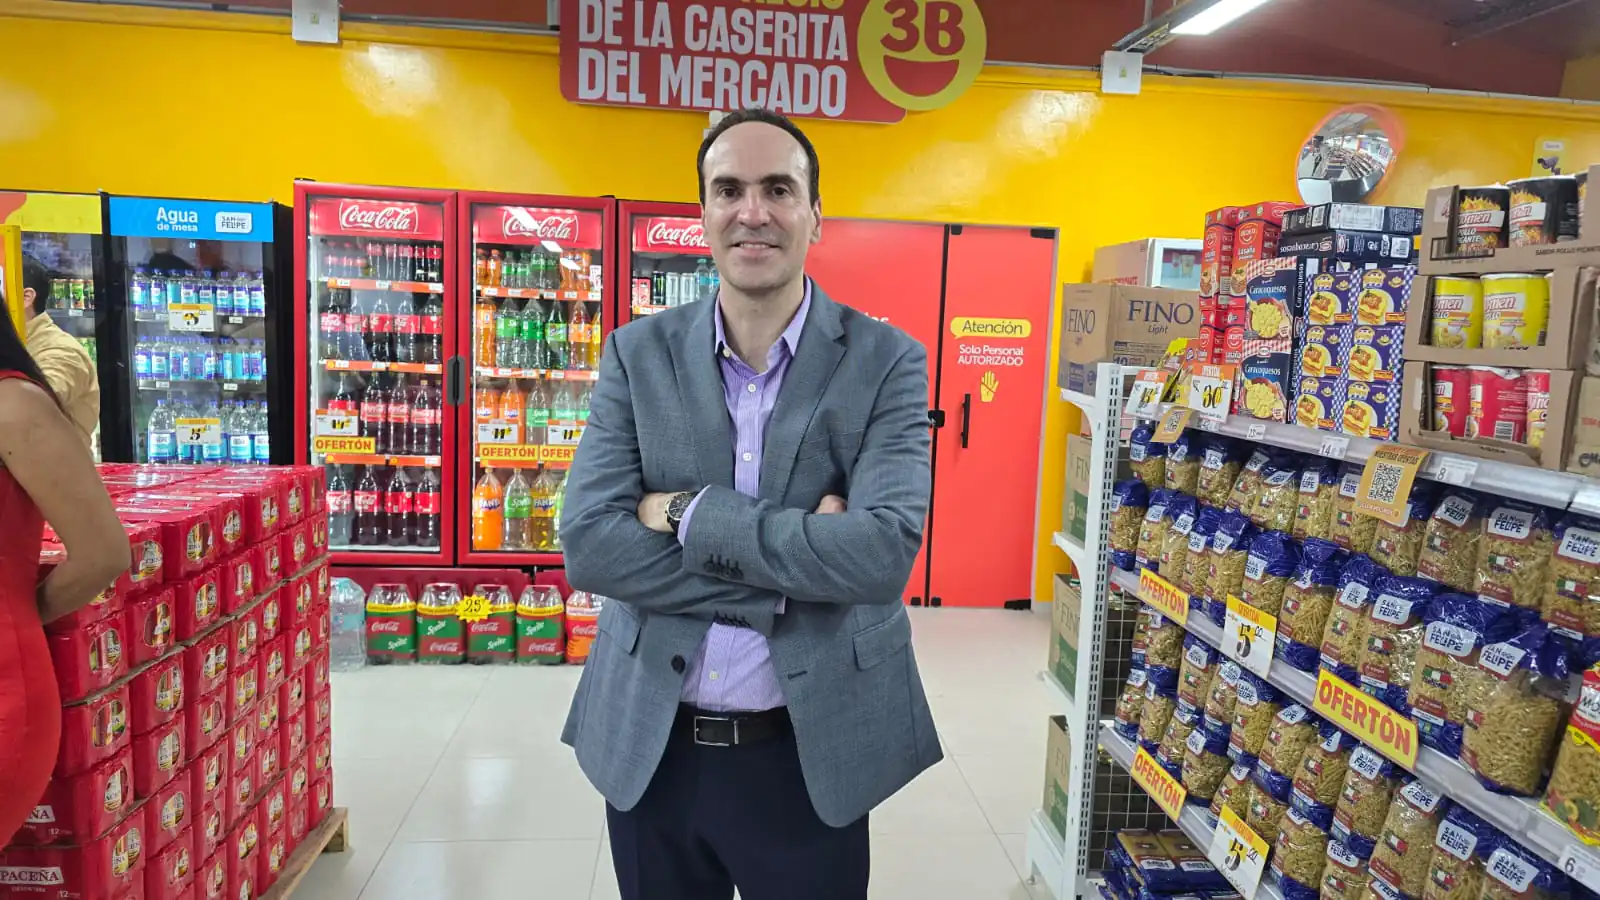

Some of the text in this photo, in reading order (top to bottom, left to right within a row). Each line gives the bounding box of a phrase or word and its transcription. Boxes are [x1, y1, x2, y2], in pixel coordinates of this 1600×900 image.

[578, 0, 849, 61] DE LA CASERITA
[879, 1, 966, 56] 3B
[577, 47, 848, 118] DEL MERCADO
[156, 206, 198, 225] Agua
[341, 203, 411, 230] Coca-Cola
[157, 223, 199, 232] de mesa
[221, 221, 247, 230] FELIPE
[1068, 308, 1096, 335] FINO
[1128, 299, 1194, 325] FINO
[962, 319, 1024, 336] Atención
[1147, 324, 1169, 337] Light
[959, 343, 1025, 356] Solo Personal
[958, 355, 1024, 367] AUTORIZADO
[315, 438, 372, 451] OFERTÓN
[481, 446, 536, 457] OFERTÓN
[542, 447, 576, 459] OFERT
[1076, 456, 1091, 478] FIN
[1437, 467, 1447, 481] 8
[1494, 519, 1525, 533] FELIPE
[1565, 542, 1598, 557] FELIPE
[1141, 574, 1185, 617] OFERTÓN
[1061, 602, 1080, 631] FIN
[1378, 607, 1401, 620] FELIPE
[1236, 622, 1251, 658] 5
[1430, 634, 1464, 652] FELIPE
[1481, 651, 1514, 671] FELIPE
[1318, 677, 1411, 757] OFERTÓN
[1056, 747, 1069, 775] FIN
[1134, 753, 1182, 812] OFERTÓN
[1224, 837, 1244, 871] 5
[1440, 834, 1470, 856] FELIPE
[1493, 862, 1525, 886] FELIPE
[1565, 857, 1577, 874] 6
[0, 870, 60, 882] PACEÑA
